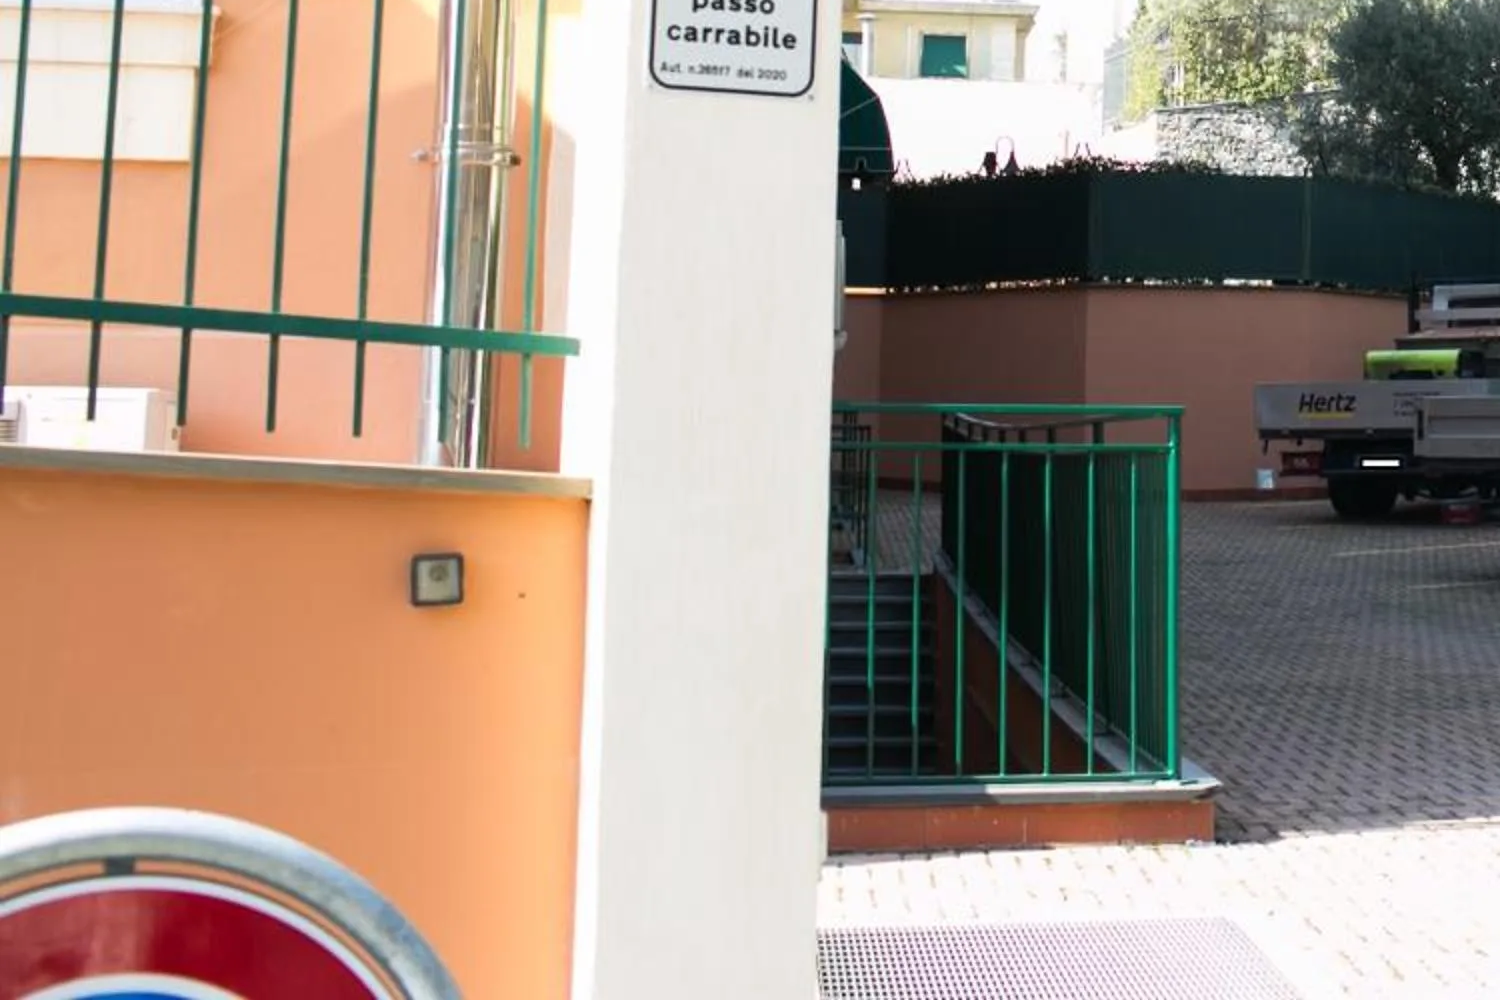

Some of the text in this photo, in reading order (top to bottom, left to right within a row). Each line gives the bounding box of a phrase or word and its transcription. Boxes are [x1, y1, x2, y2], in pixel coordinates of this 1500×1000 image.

[667, 24, 797, 49] carrabile
[757, 69, 788, 81] 2020
[1299, 393, 1357, 413] Hertz
